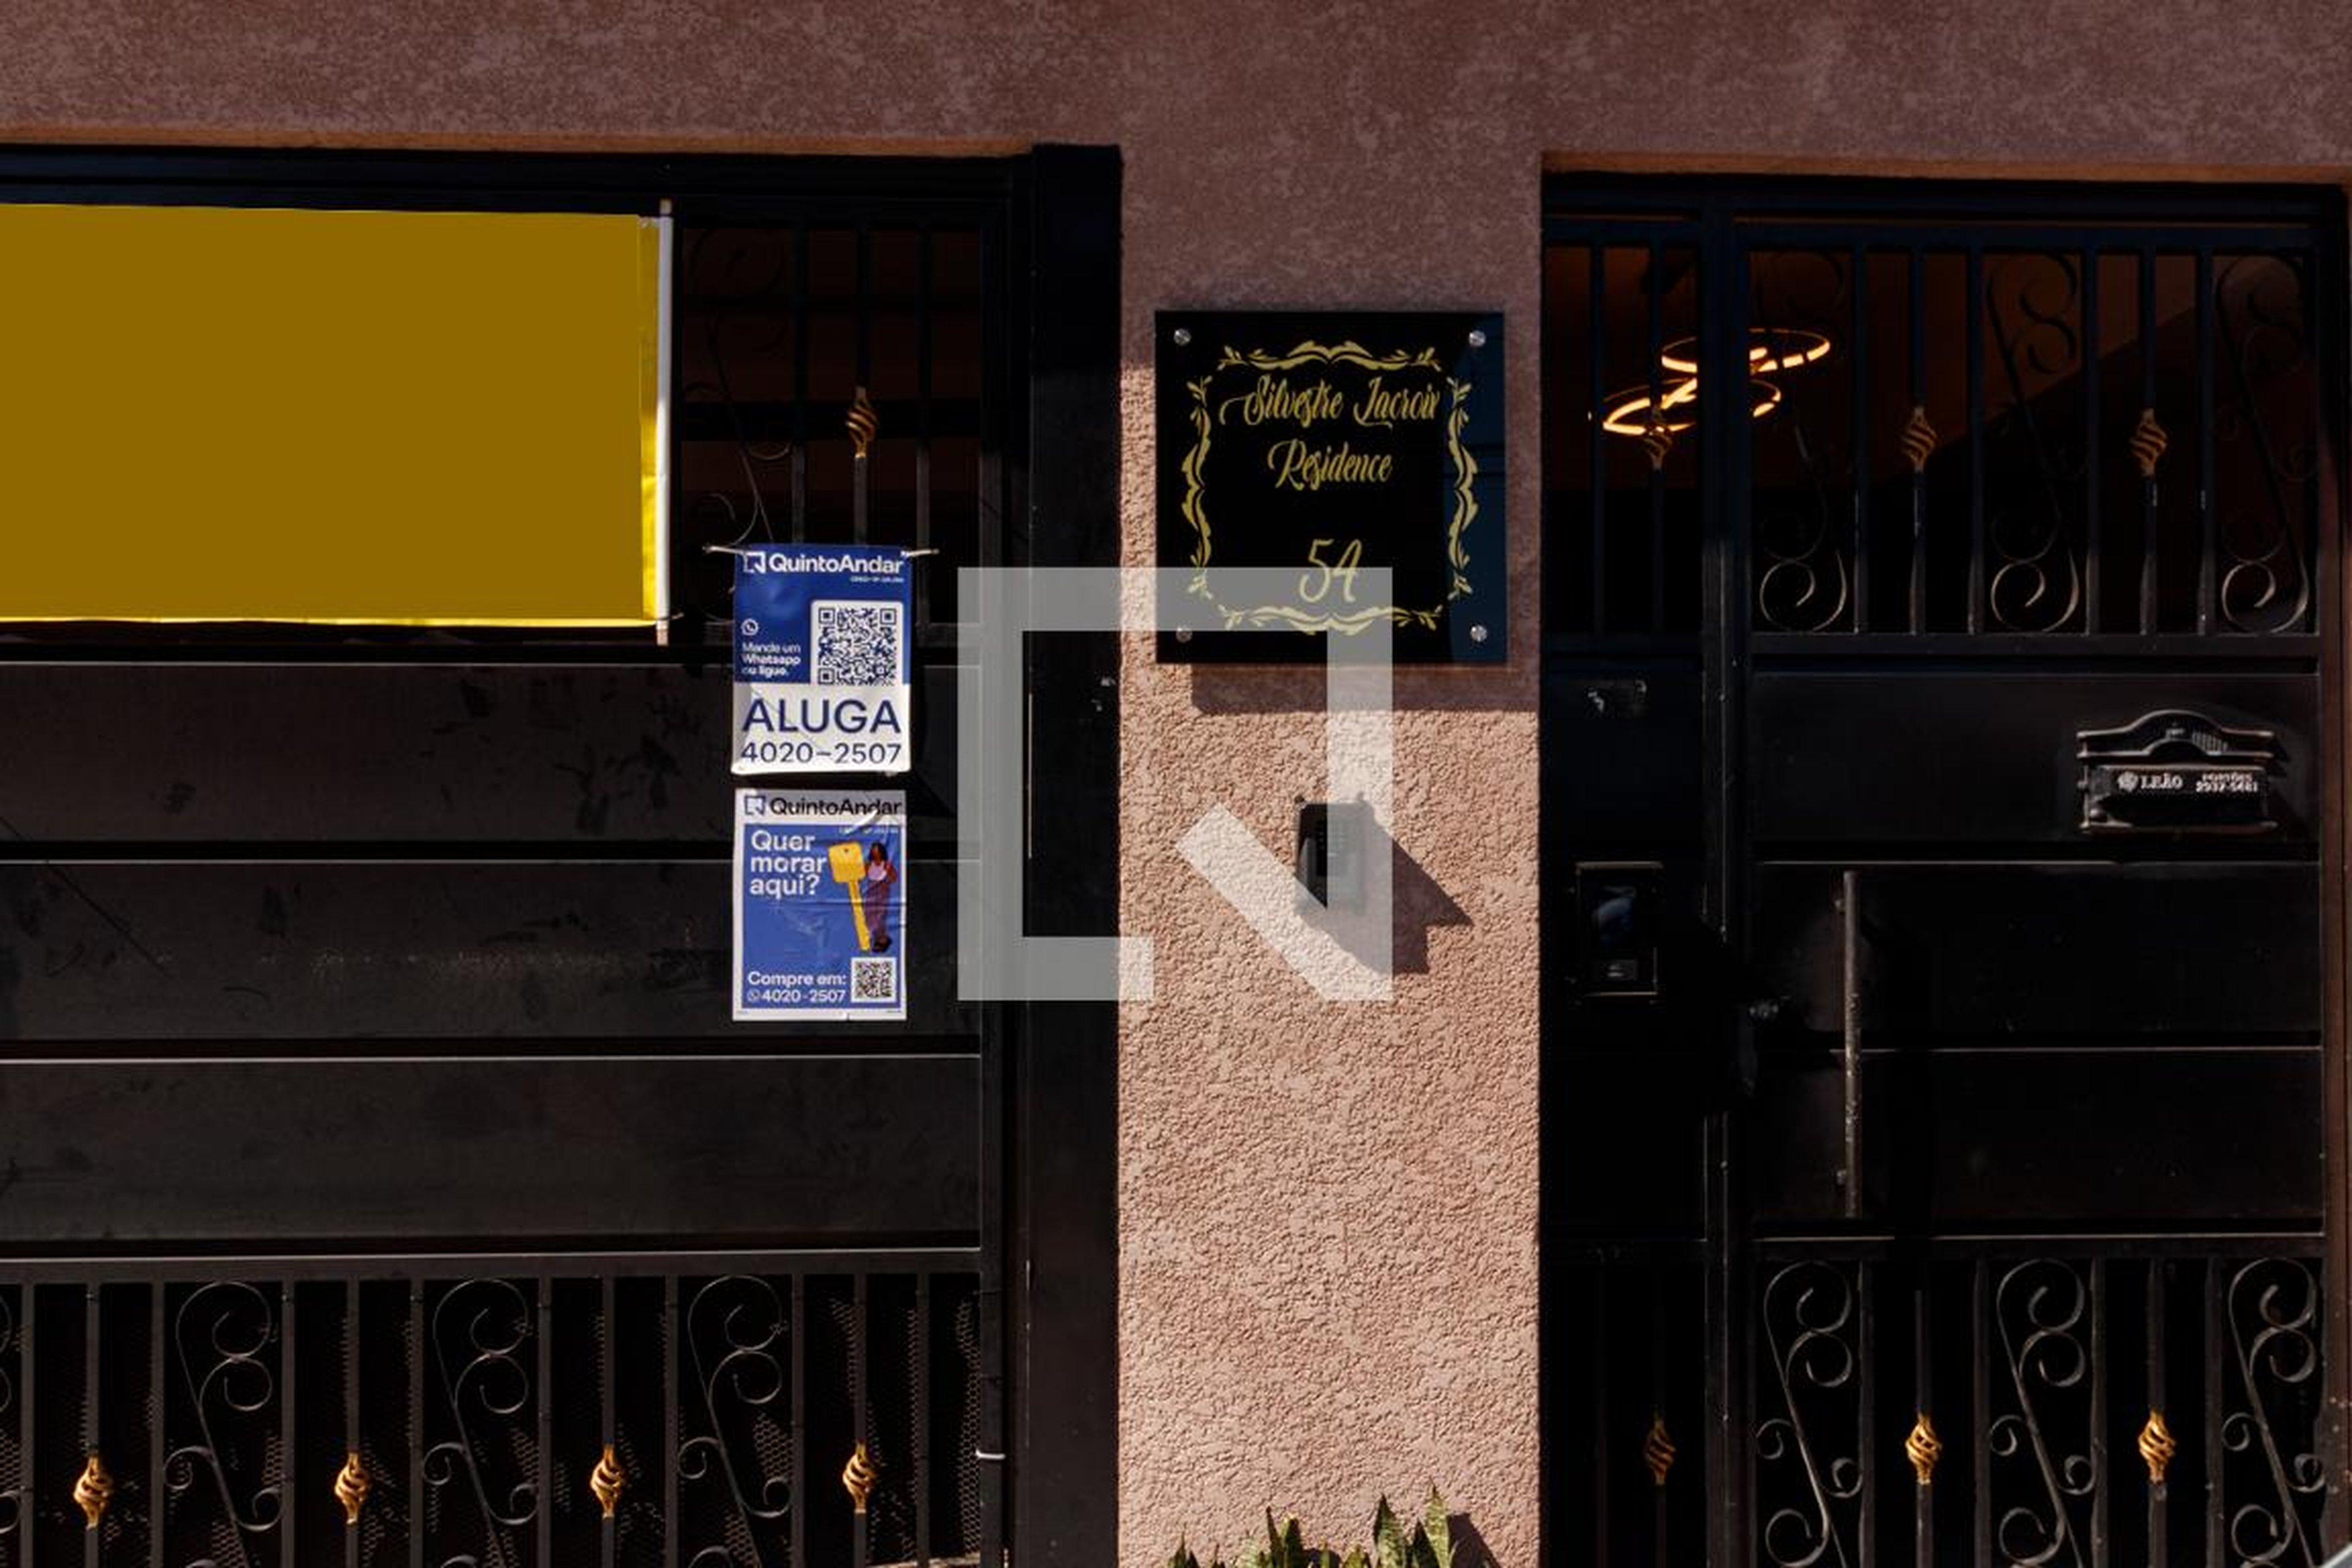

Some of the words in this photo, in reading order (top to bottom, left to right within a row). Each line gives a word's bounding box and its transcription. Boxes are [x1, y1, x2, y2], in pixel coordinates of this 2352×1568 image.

[1219, 374, 1343, 428] Silvestre
[1267, 438, 1393, 491] Residence
[769, 553, 904, 573] QuintoAndar
[742, 642, 780, 654] Mande
[783, 644, 801, 654] um
[742, 654, 801, 666] Whatsapp
[742, 698, 901, 734] ALUGA
[741, 742, 902, 764] 4020-2507
[2140, 772, 2183, 790] LEÃO
[769, 797, 903, 816] QuintoAndar
[750, 829, 815, 852] Quer
[750, 856, 827, 873] morar
[749, 874, 820, 899] aqui?
[747, 971, 813, 988] Compre
[816, 973, 846, 986] em:
[761, 989, 846, 1003] 4020-2507
